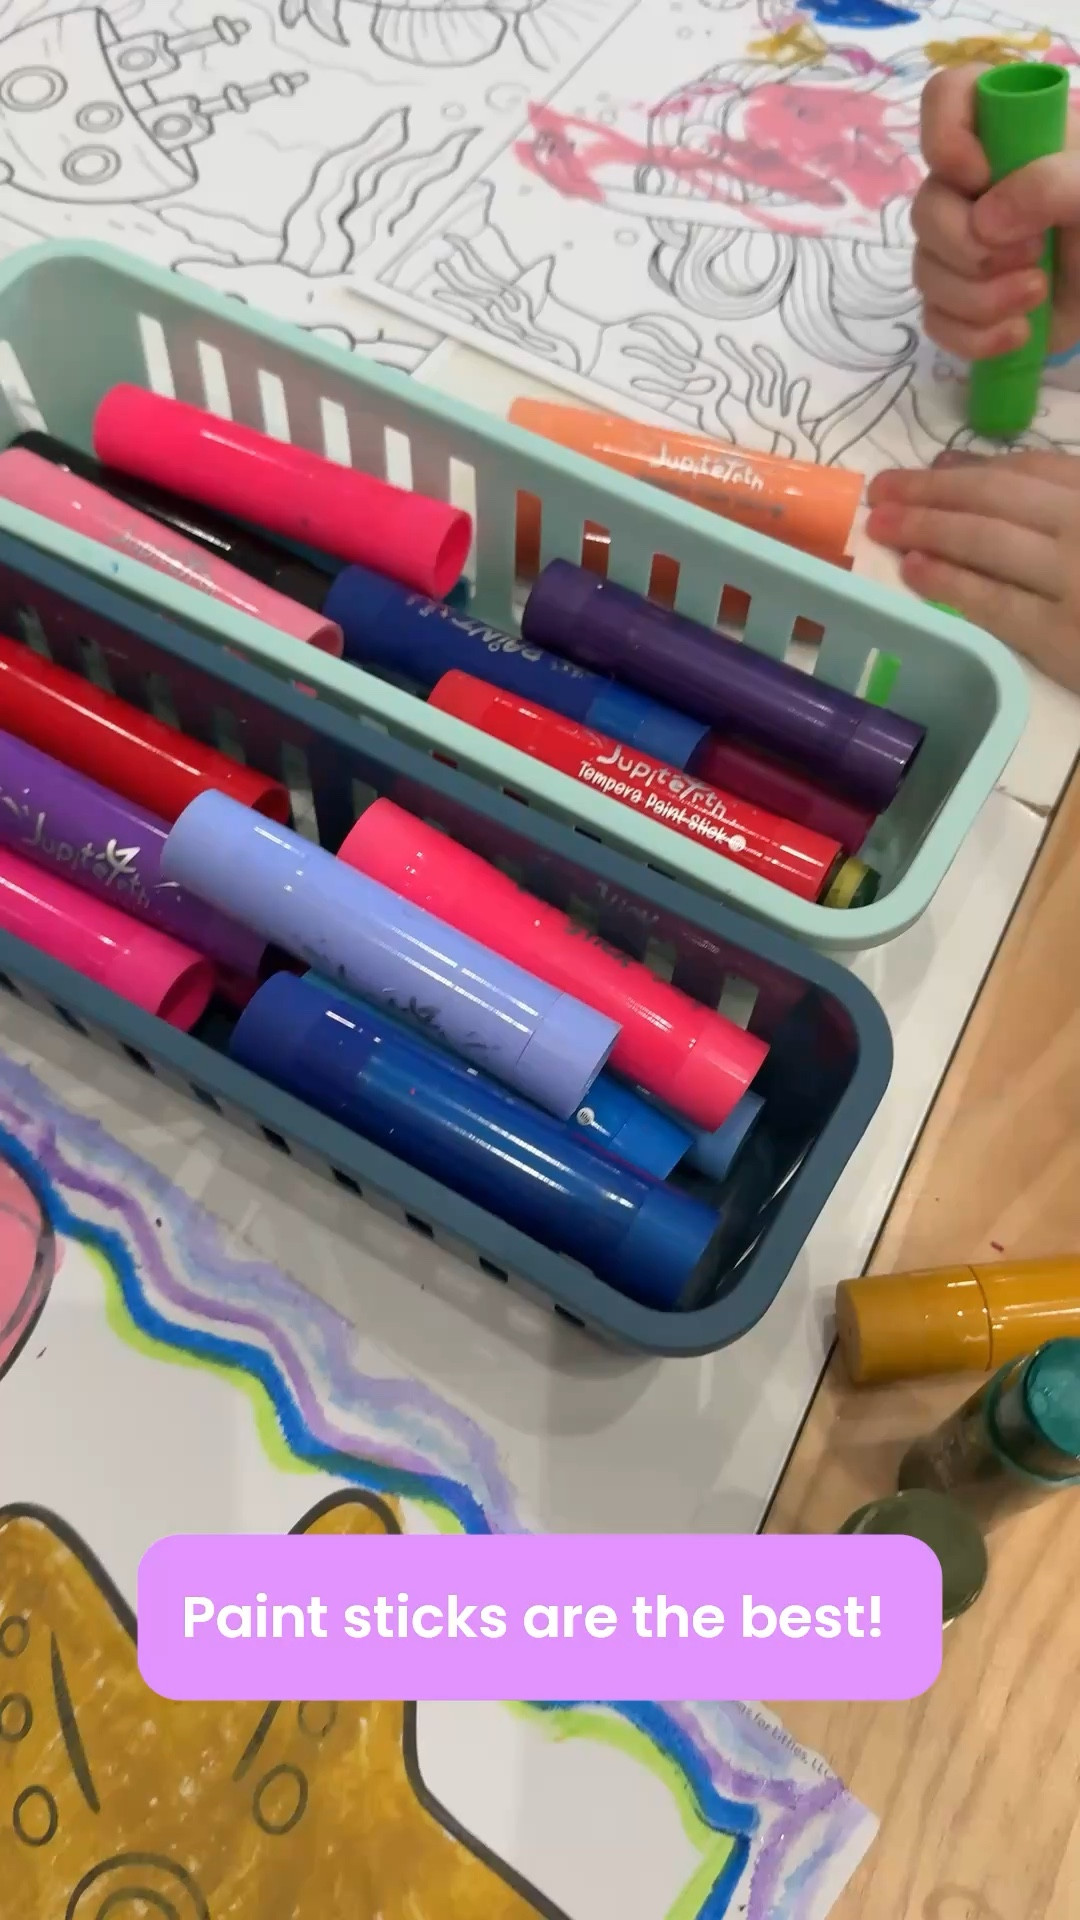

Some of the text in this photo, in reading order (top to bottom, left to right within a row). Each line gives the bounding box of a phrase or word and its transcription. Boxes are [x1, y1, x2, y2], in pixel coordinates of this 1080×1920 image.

[578, 760, 729, 844] Tempera Paint Stick
